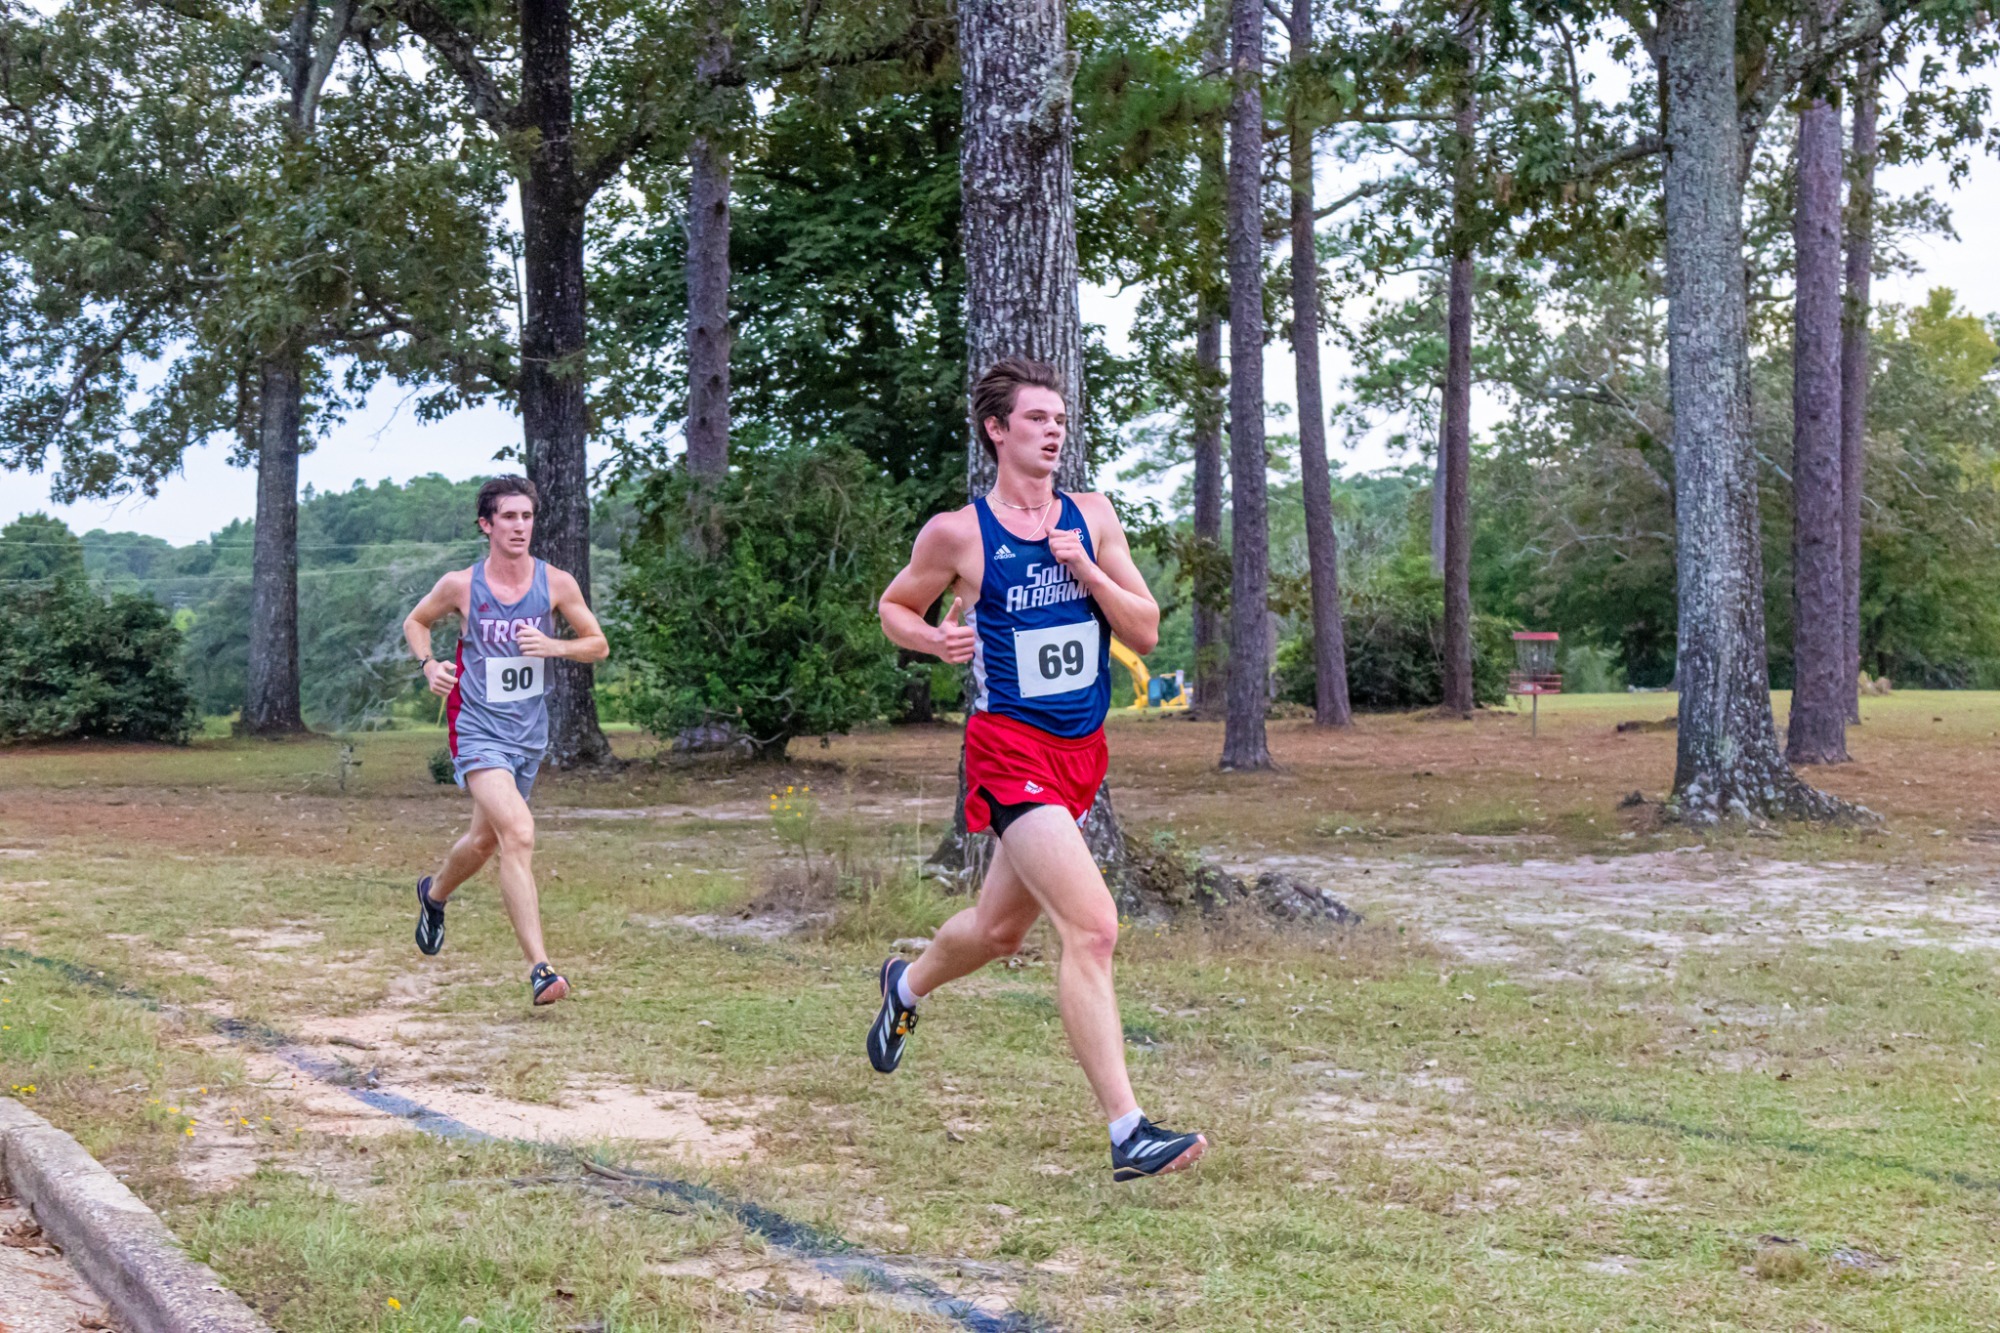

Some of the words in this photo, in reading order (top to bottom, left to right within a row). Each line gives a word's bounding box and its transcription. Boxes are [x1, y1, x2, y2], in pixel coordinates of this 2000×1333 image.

[1025, 563, 1072, 589] SOU
[1038, 640, 1084, 680] 69
[501, 666, 534, 692] 90
